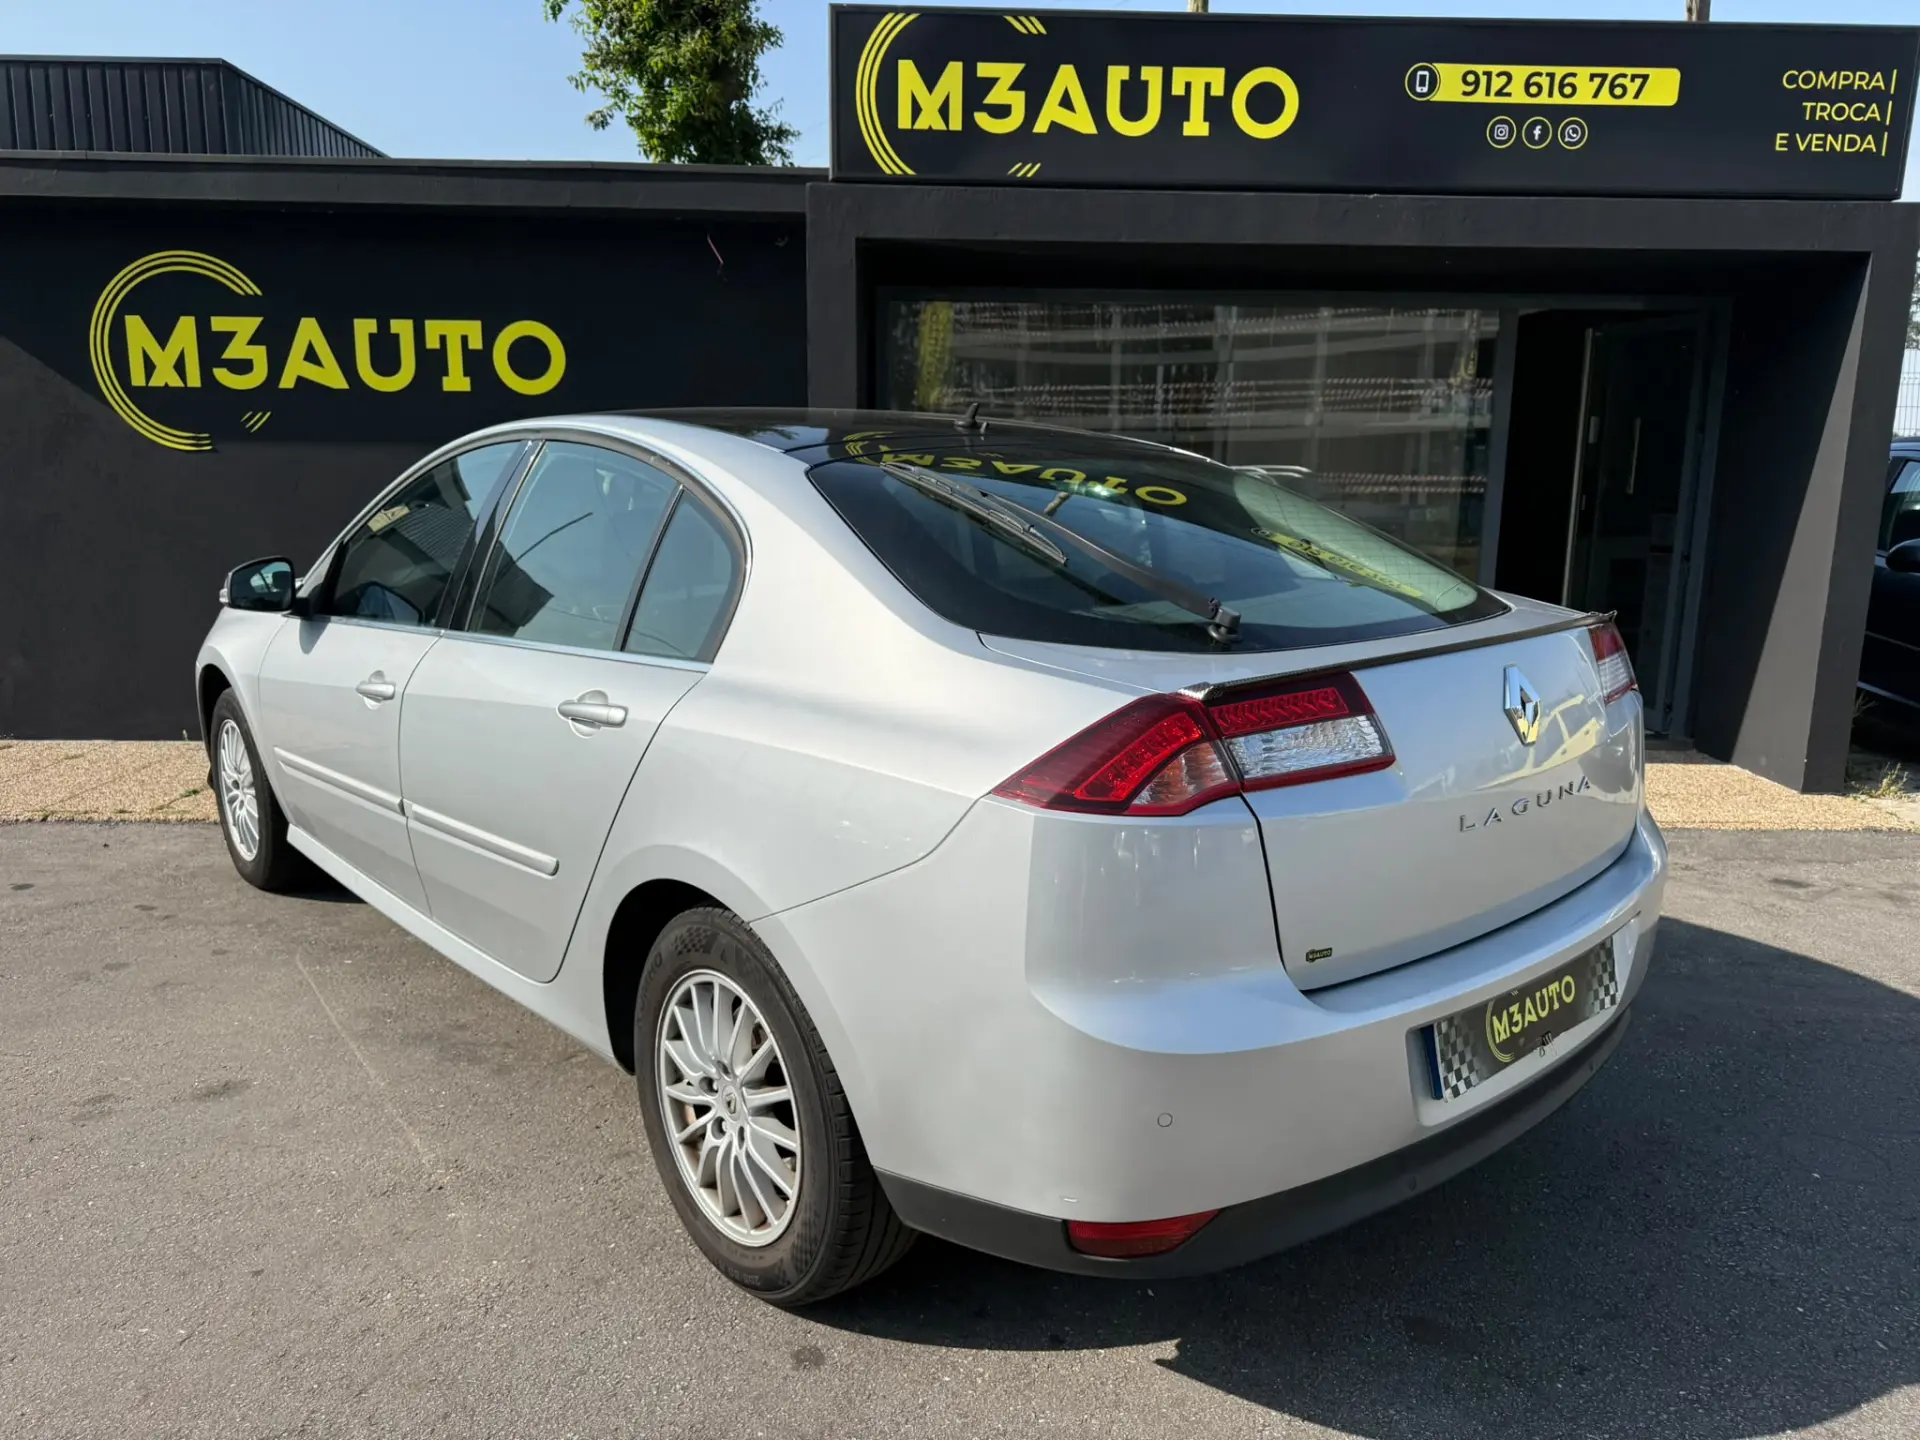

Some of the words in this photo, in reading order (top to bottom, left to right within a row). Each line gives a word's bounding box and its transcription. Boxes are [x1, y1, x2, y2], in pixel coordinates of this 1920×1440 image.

[897, 59, 1299, 139] M3AUTO
[1460, 69, 1514, 98] 912
[1523, 71, 1578, 100] 616
[1588, 72, 1651, 101] 767
[1782, 70, 1886, 91] COMPRA
[1801, 101, 1882, 122] TROCA
[1774, 132, 1790, 151] E
[1795, 132, 1878, 153] VENDA
[124, 314, 566, 395] M3AUTO
[1458, 775, 1591, 833] LAGUNA
[1491, 974, 1576, 1045] M3AUTO
